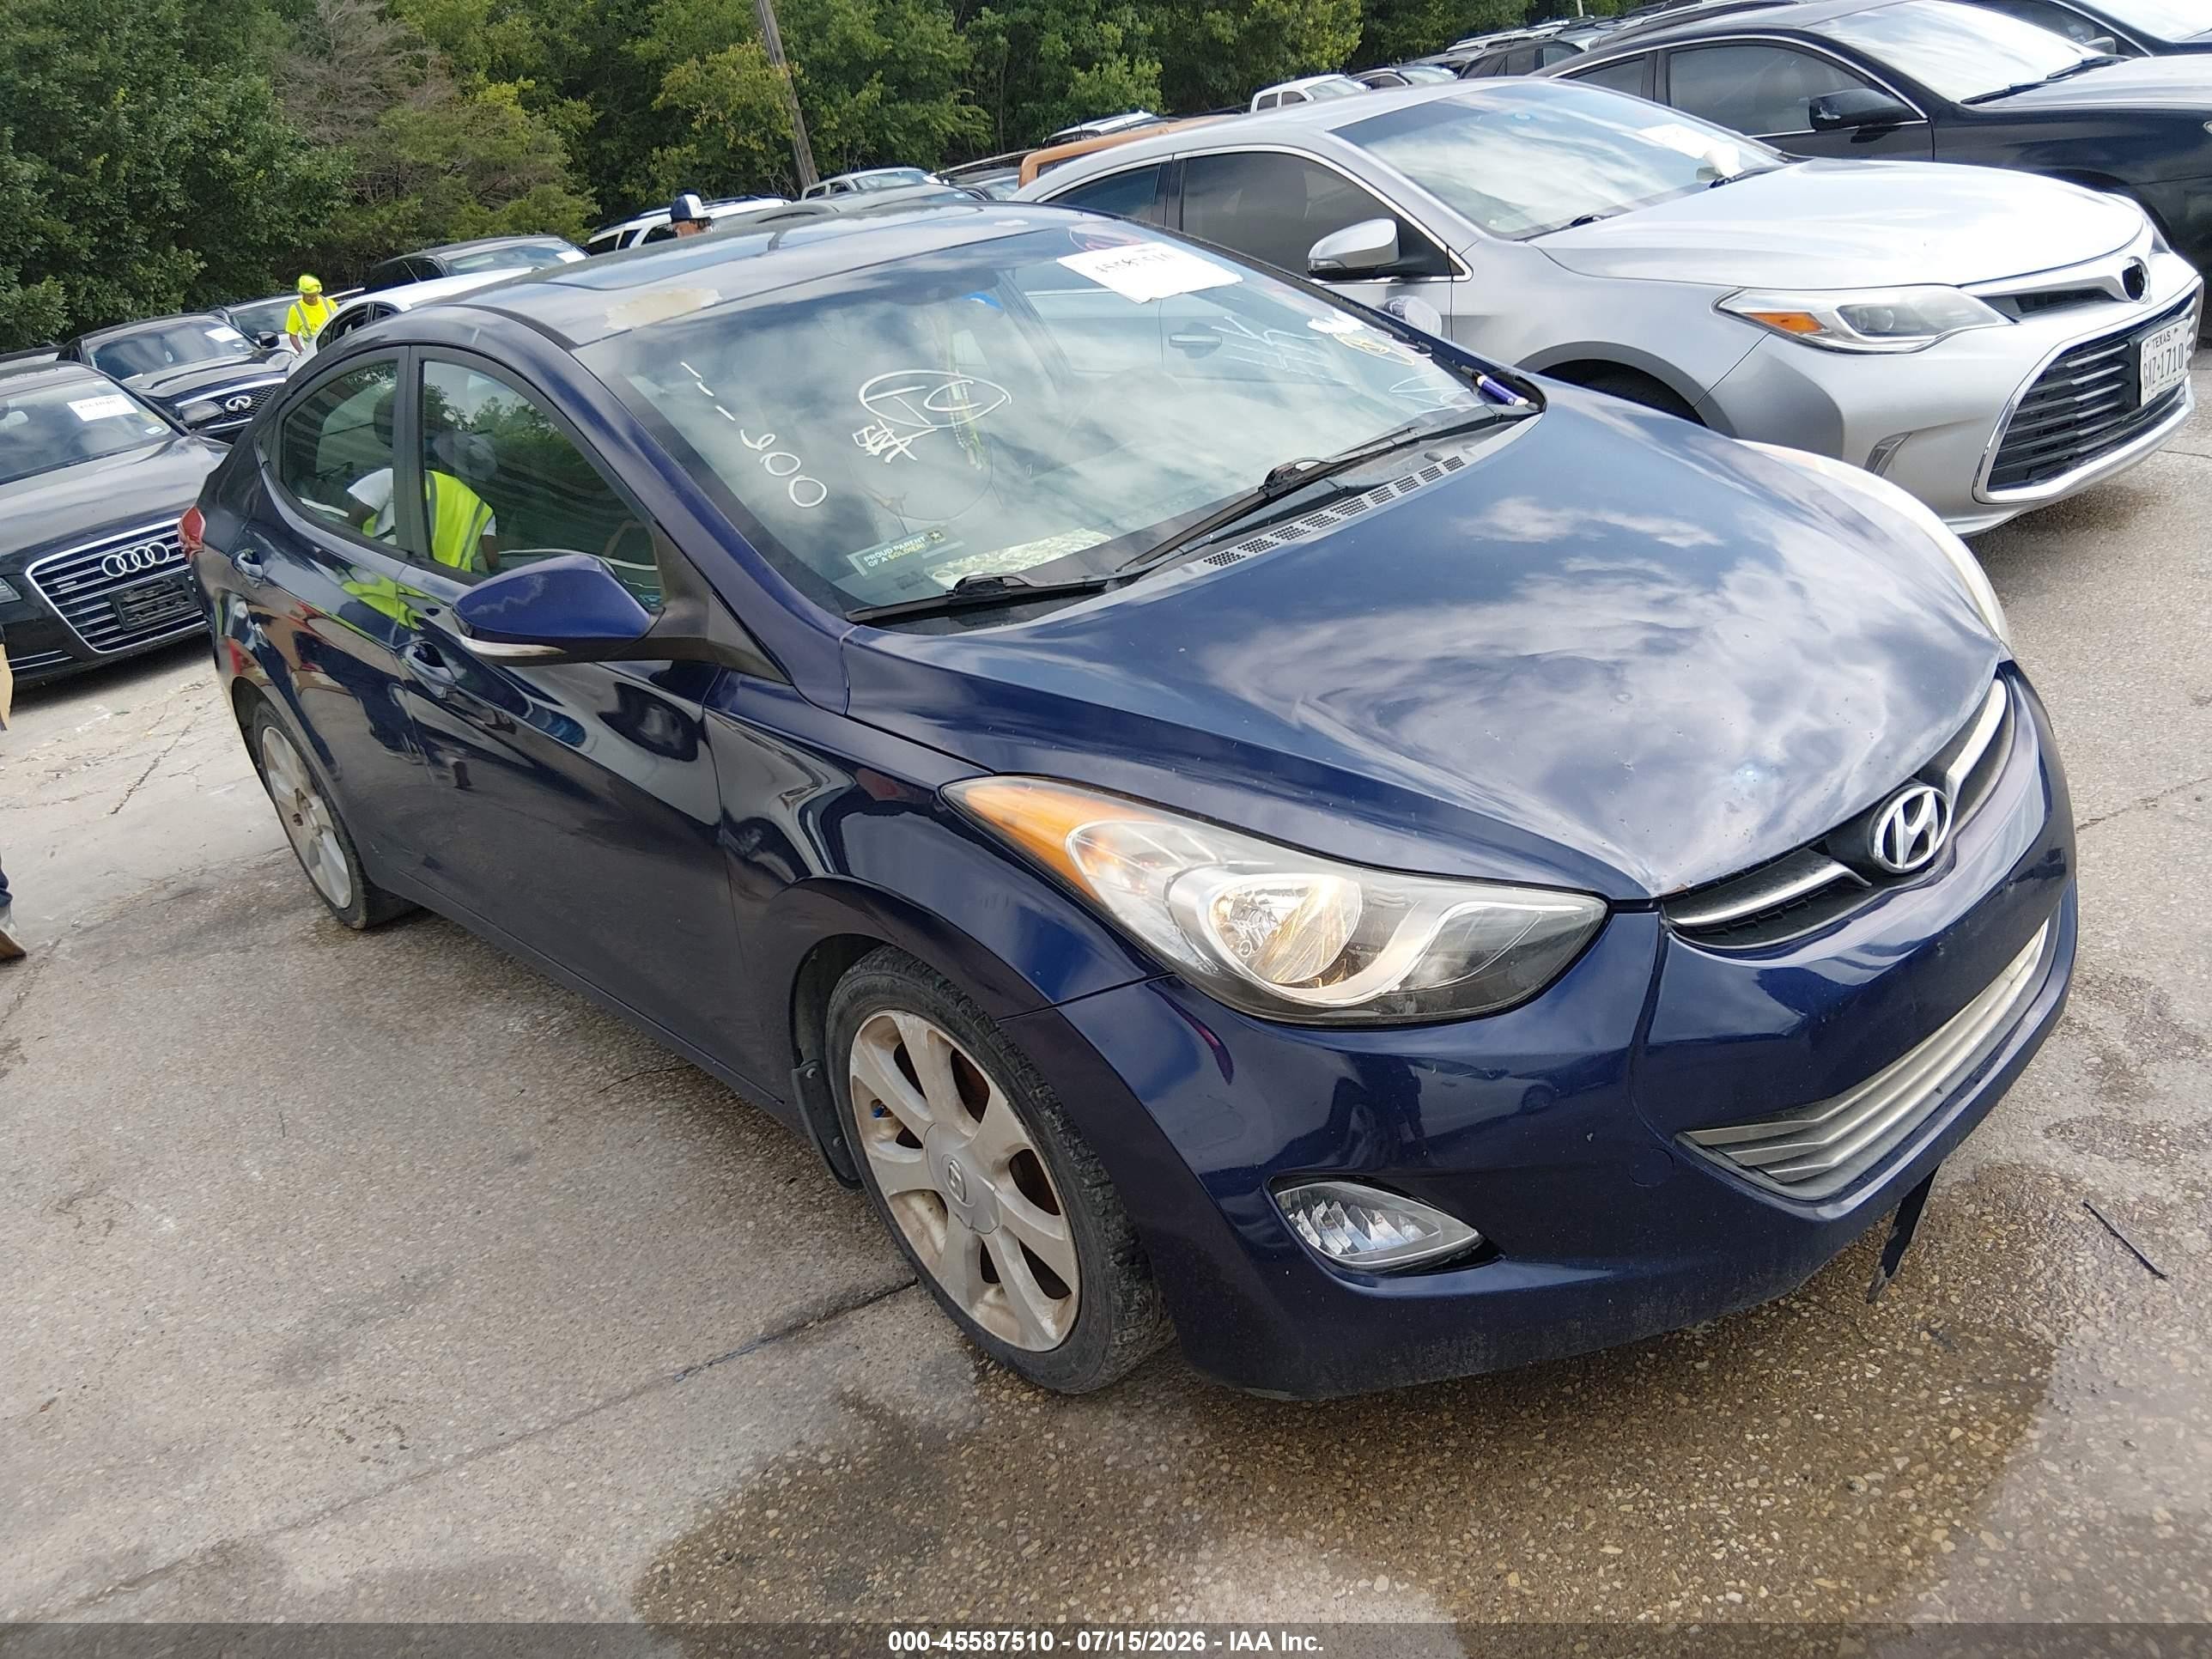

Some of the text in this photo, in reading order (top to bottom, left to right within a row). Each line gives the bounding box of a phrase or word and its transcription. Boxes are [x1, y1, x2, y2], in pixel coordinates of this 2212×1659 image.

[2152, 331, 2172, 349] TEXAS
[863, 547, 893, 562] PROUD
[892, 536, 926, 553] PARENT
